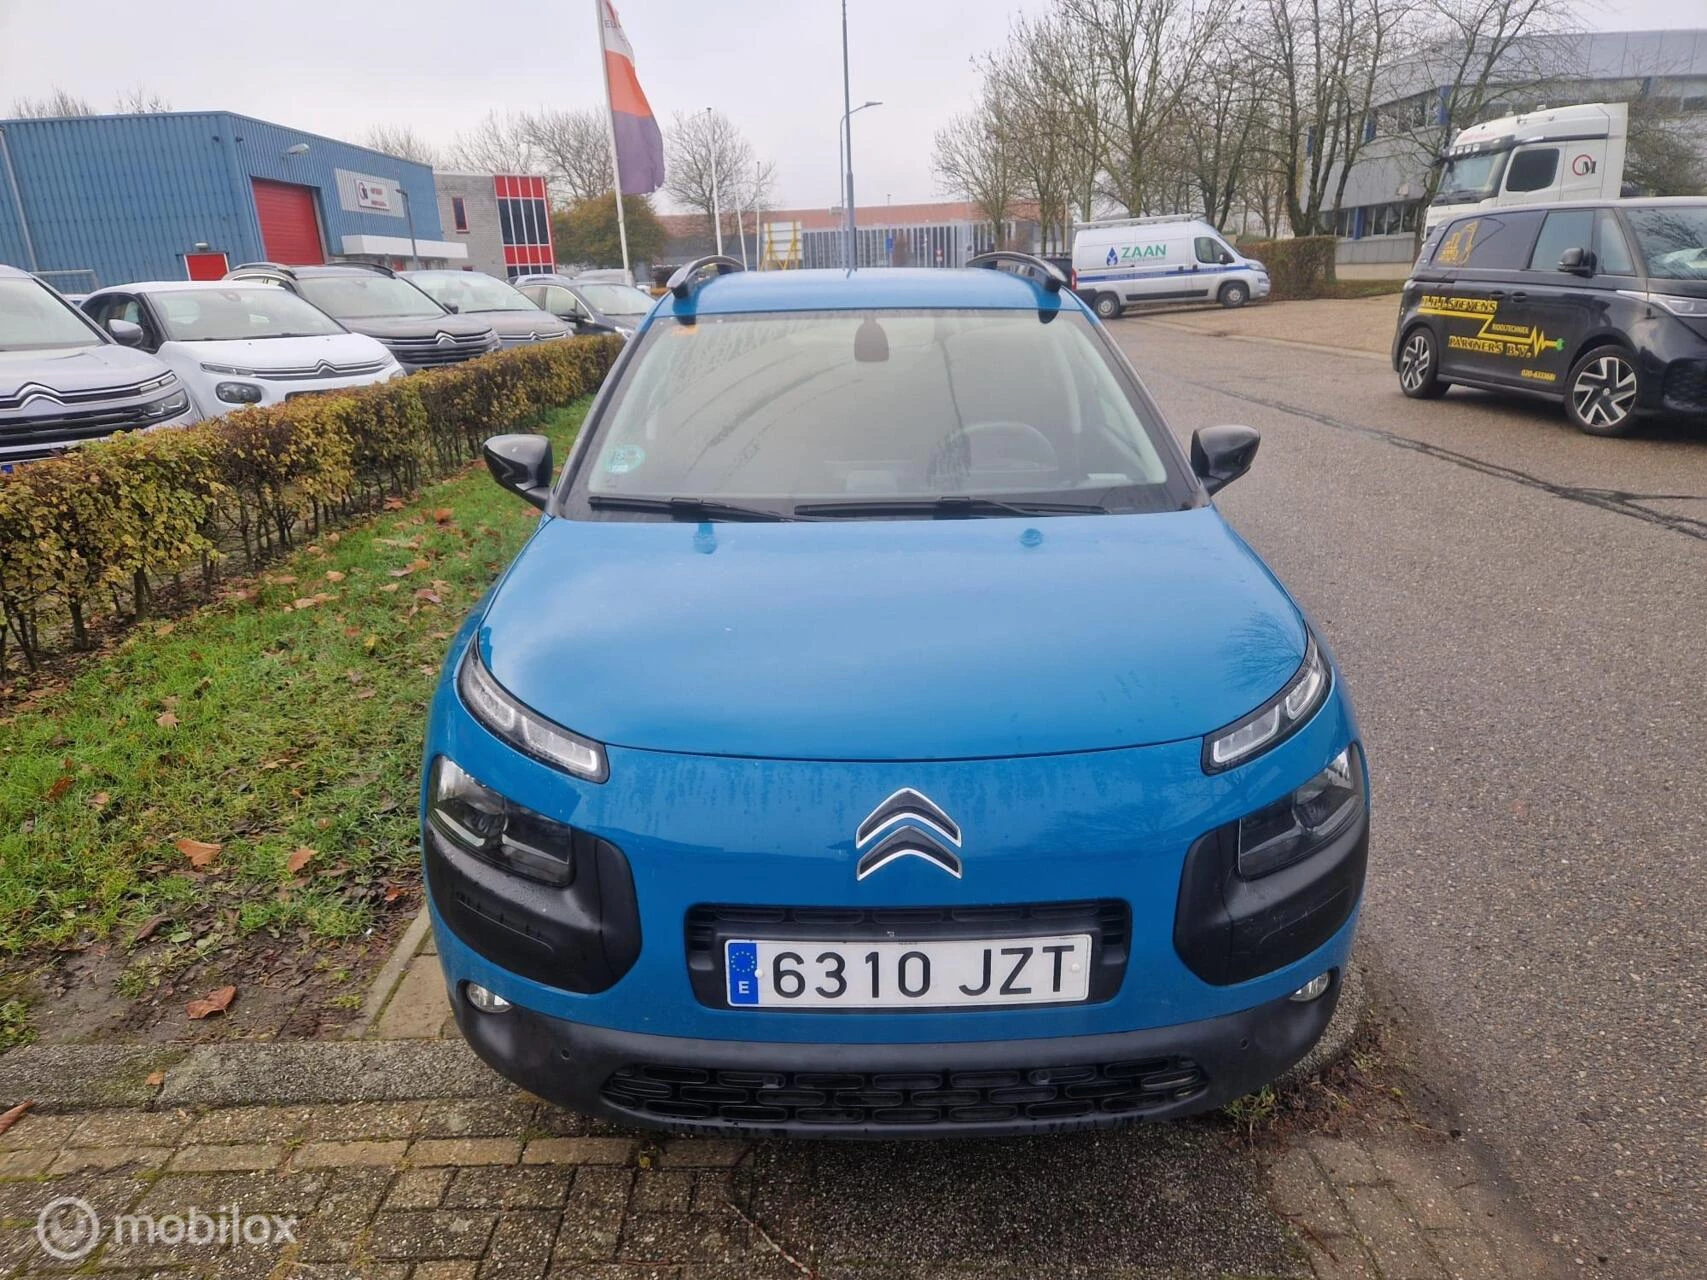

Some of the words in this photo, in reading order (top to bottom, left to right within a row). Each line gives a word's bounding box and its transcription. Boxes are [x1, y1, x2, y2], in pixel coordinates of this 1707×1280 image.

[1121, 244, 1167, 258] ZAAN
[1448, 335, 1503, 354] PARTNERS
[1505, 343, 1532, 358] B.V.
[772, 951, 931, 999] 6310
[958, 945, 1075, 996] JZT
[738, 981, 749, 994] E
